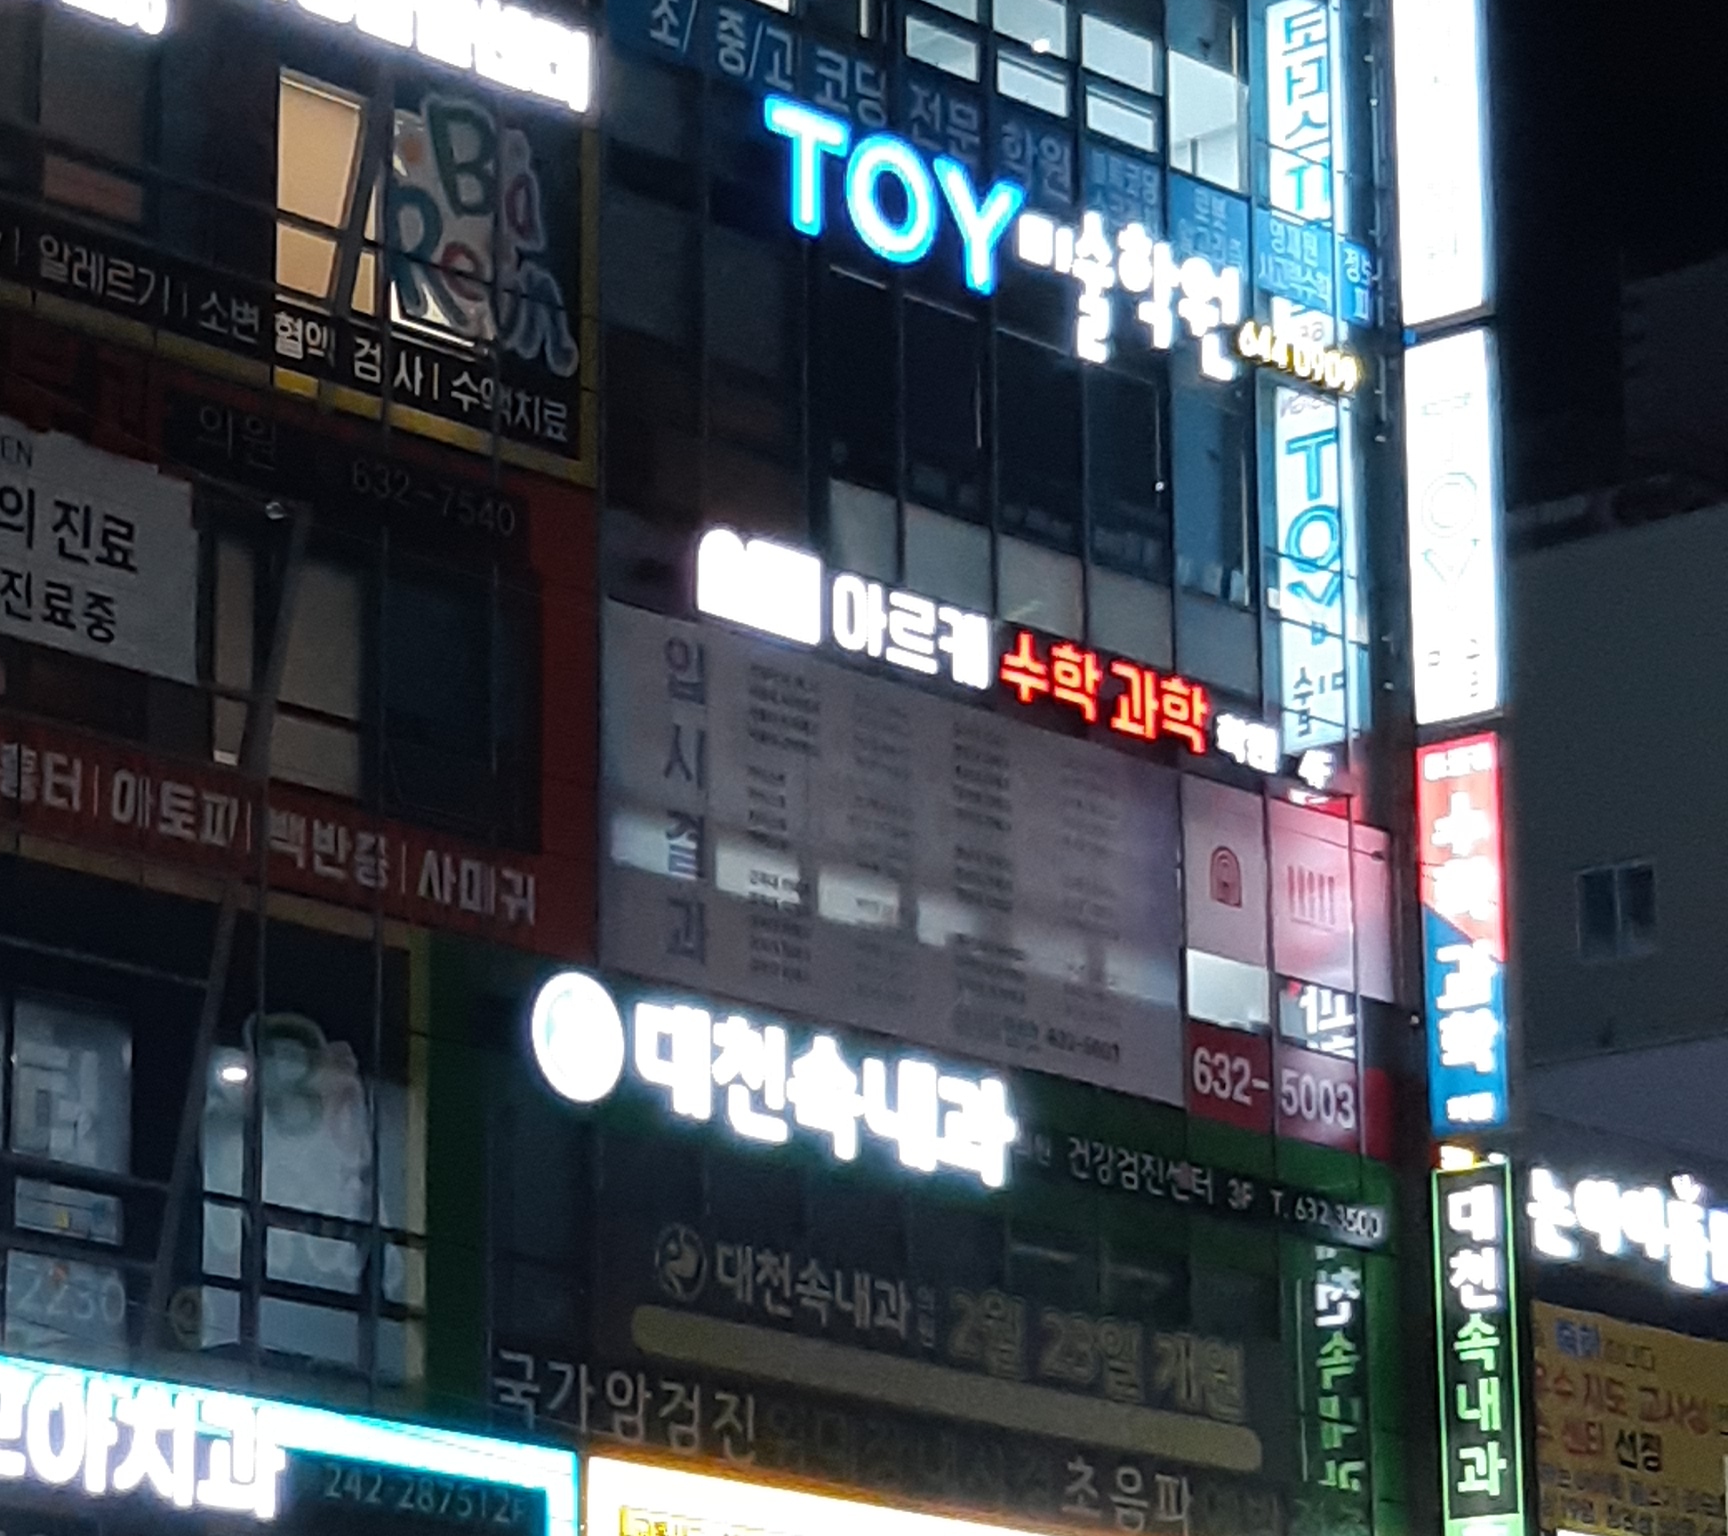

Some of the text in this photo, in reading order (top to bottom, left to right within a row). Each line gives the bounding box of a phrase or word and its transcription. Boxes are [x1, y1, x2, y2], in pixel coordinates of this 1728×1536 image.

[763, 95, 1027, 298] TOY
[39, 233, 170, 309] 알레르기
[52, 498, 140, 573] 진료
[831, 573, 991, 690] 아르케
[1000, 631, 1103, 723] 수학
[1111, 660, 1210, 753] 과학
[111, 770, 240, 846] 아토피
[267, 804, 390, 890] 백반증
[417, 850, 536, 926] 사마귀
[1068, 1134, 1215, 1206] 건강검진센터
[1153, 1331, 1248, 1421] 개원
[1445, 1183, 1507, 1498] 대천속내과
[494, 1350, 758, 1464] 국가암검진
